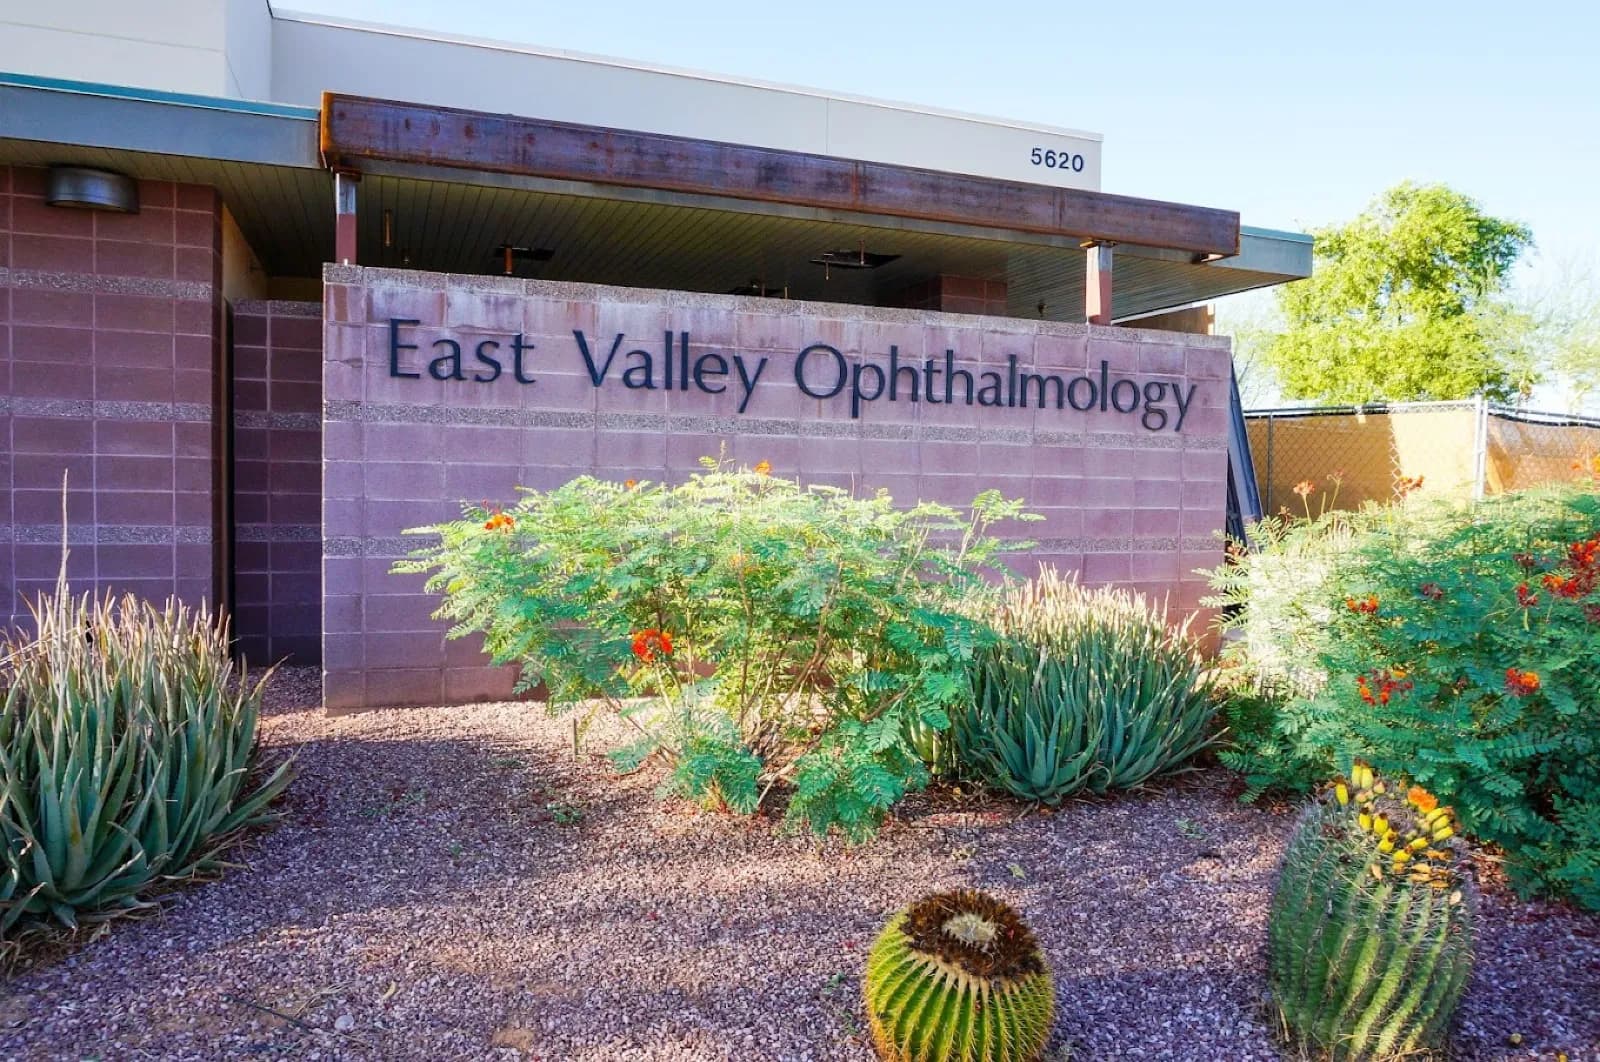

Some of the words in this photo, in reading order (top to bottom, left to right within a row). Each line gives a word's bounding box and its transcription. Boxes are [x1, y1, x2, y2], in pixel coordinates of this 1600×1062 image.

[1031, 147, 1084, 172] 5620
[389, 318, 537, 384] East
[572, 329, 768, 414] Valley
[794, 343, 1197, 432] Ophthalmology
